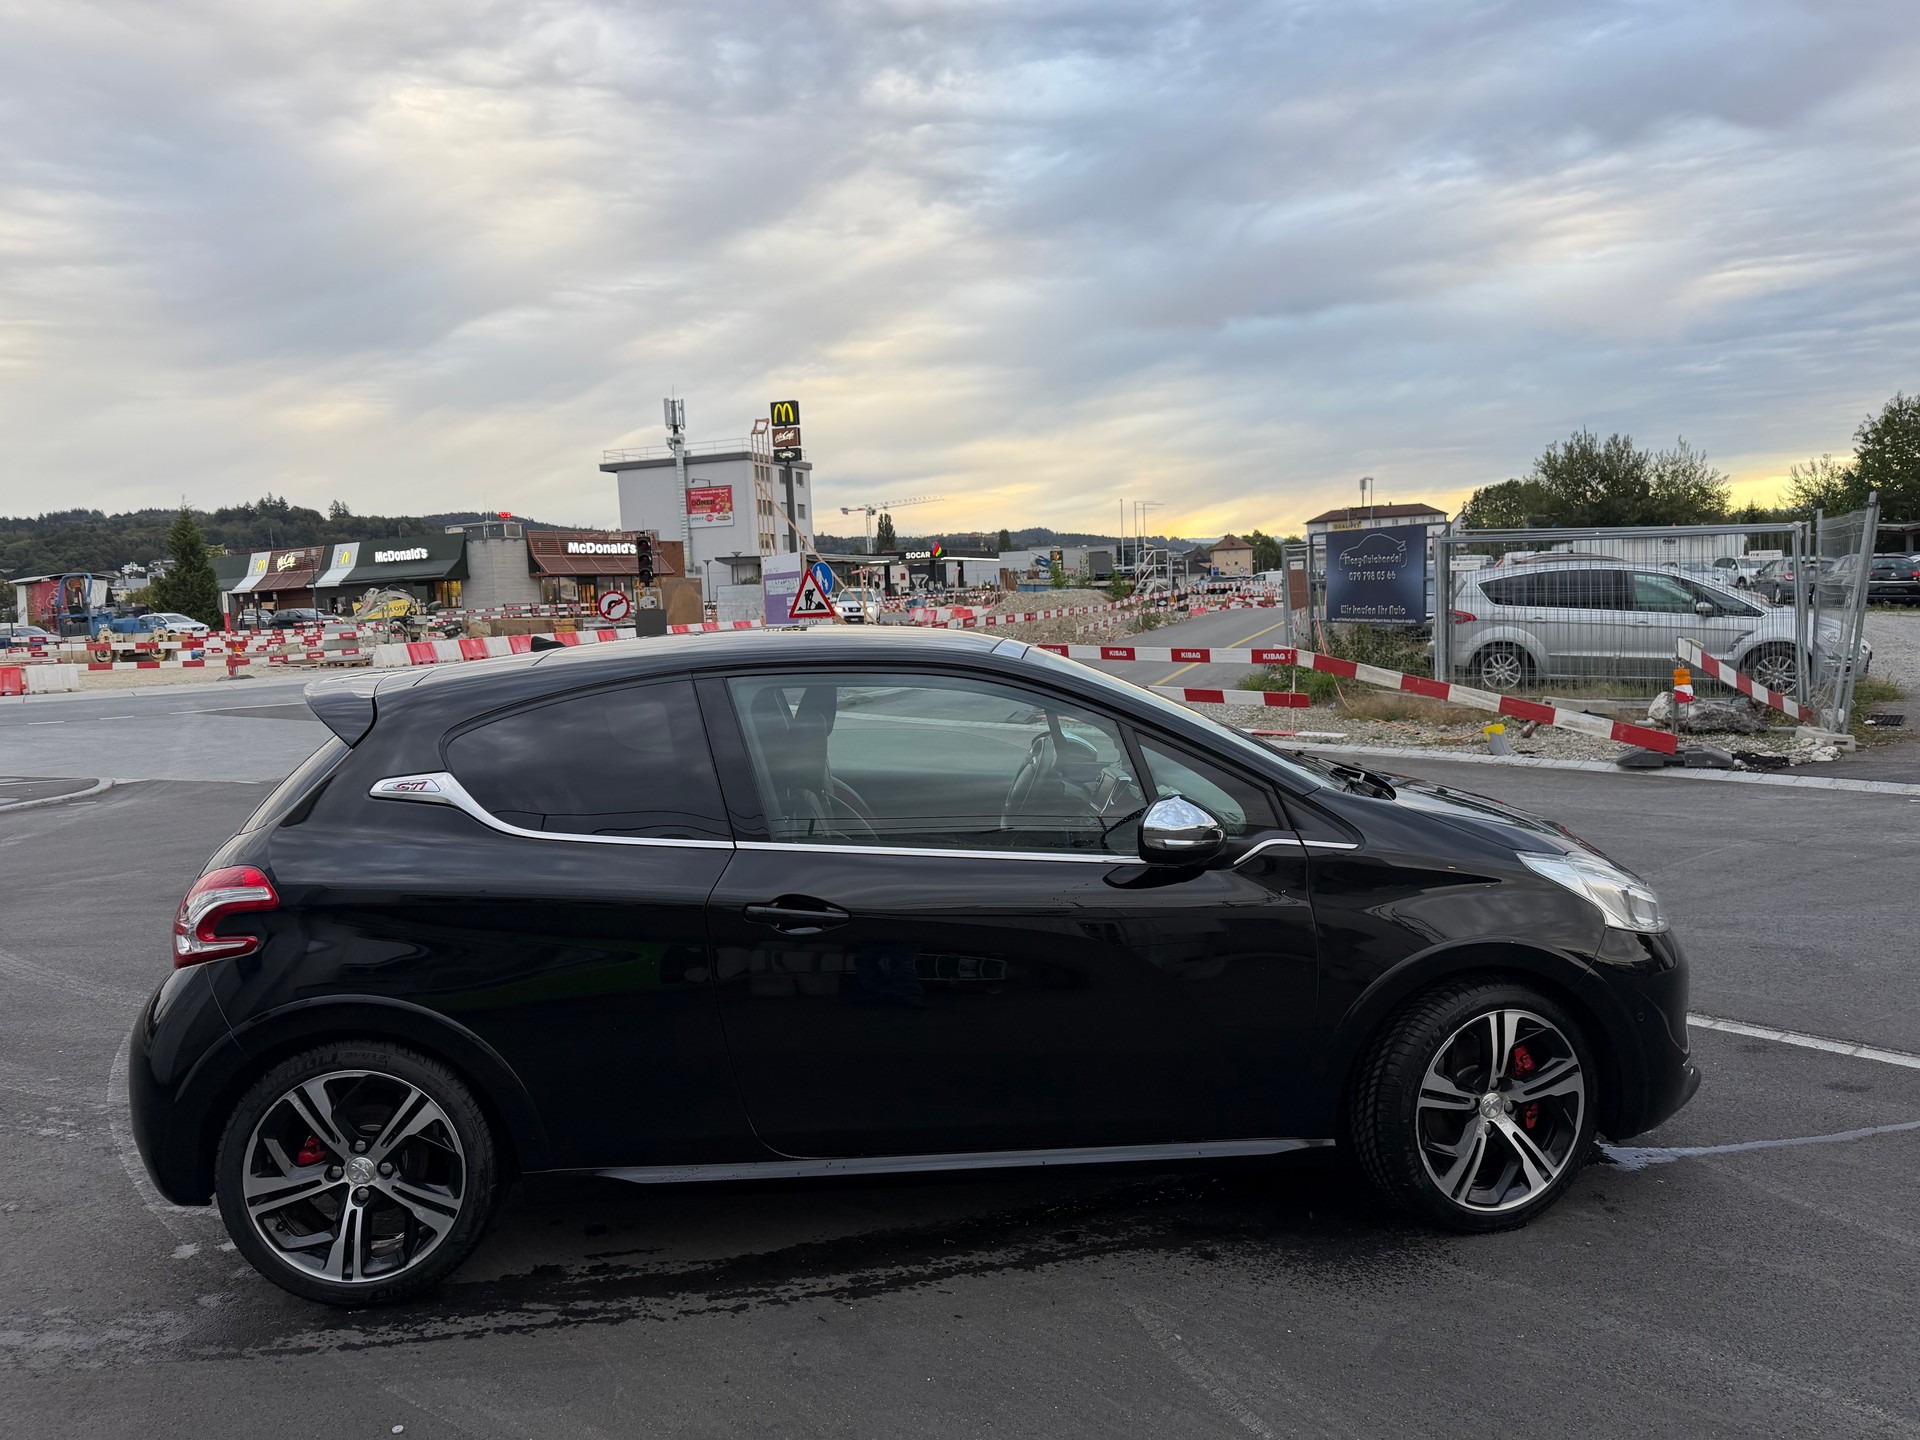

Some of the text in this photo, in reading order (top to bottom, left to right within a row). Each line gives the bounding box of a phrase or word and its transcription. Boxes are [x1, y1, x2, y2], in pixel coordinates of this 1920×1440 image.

[567, 542, 637, 555] McDonald's
[375, 548, 428, 563] McDonald's
[905, 550, 931, 560] SOCAR
[1348, 571, 1361, 581] 079
[1340, 604, 1406, 615] Wir kaufen Ihr Auto
[1180, 651, 1201, 659] KIBAG
[1262, 653, 1286, 661] KIBAG
[394, 781, 428, 791] GTI
